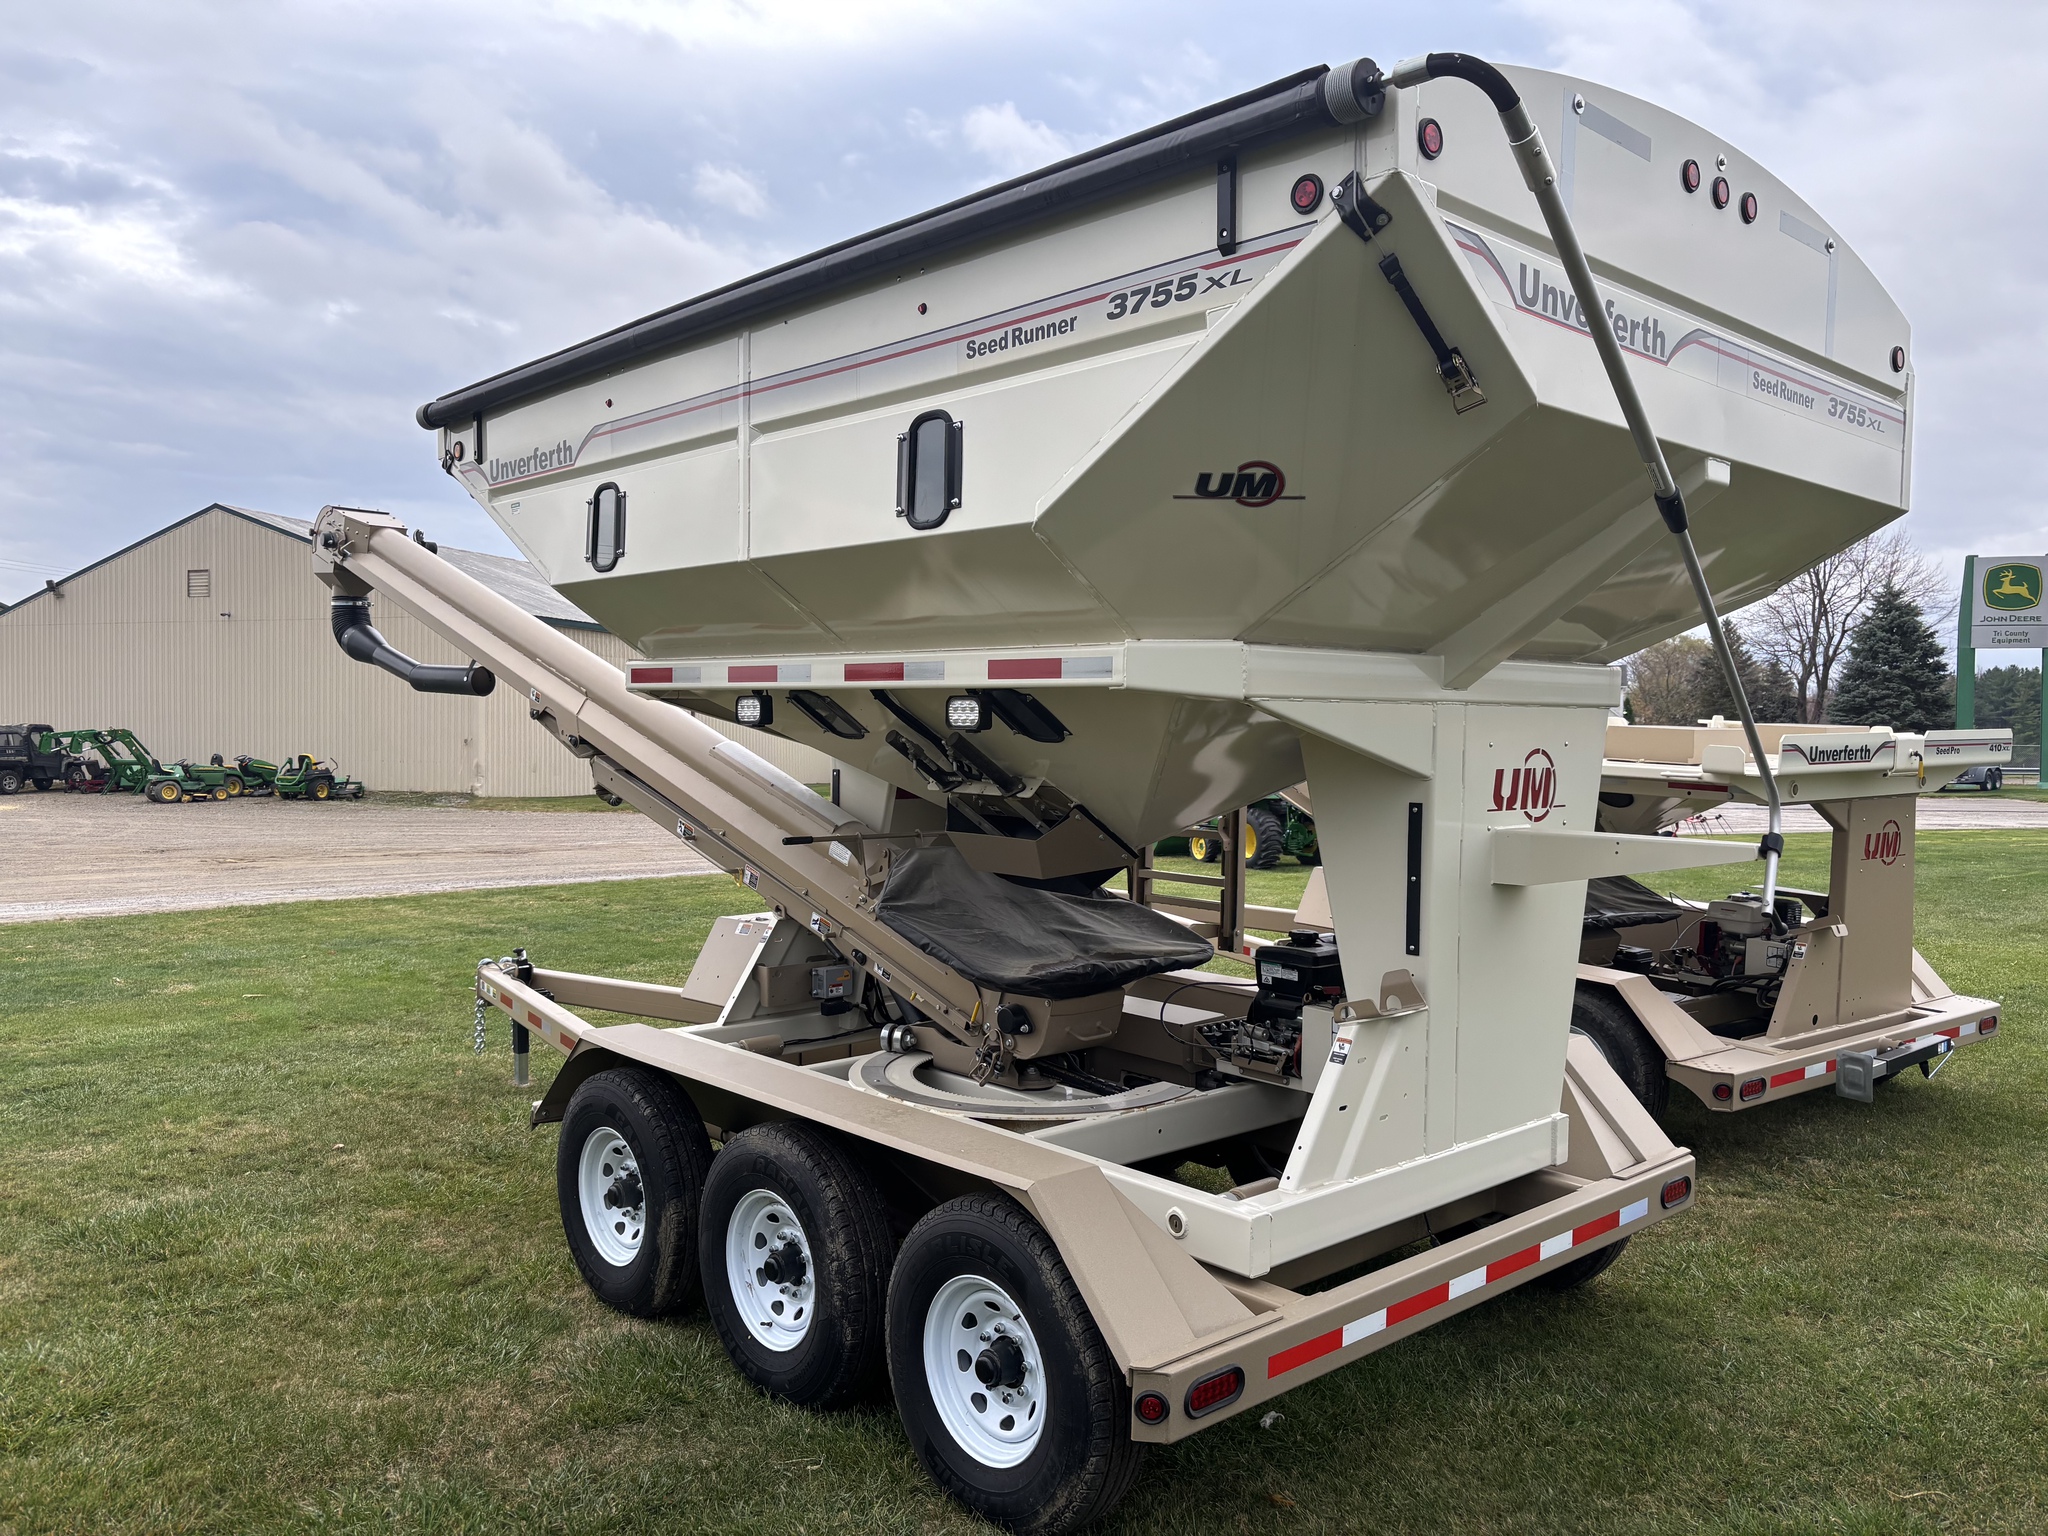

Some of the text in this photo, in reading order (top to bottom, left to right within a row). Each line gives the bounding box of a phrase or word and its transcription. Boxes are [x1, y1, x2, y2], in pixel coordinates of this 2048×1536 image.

[1519, 262, 1667, 358] Unveferth
[489, 440, 573, 482] Unverferth
[2009, 614, 2042, 622] DEERE
[2004, 630, 2029, 638] County
[1809, 744, 1871, 762] Unverferth
